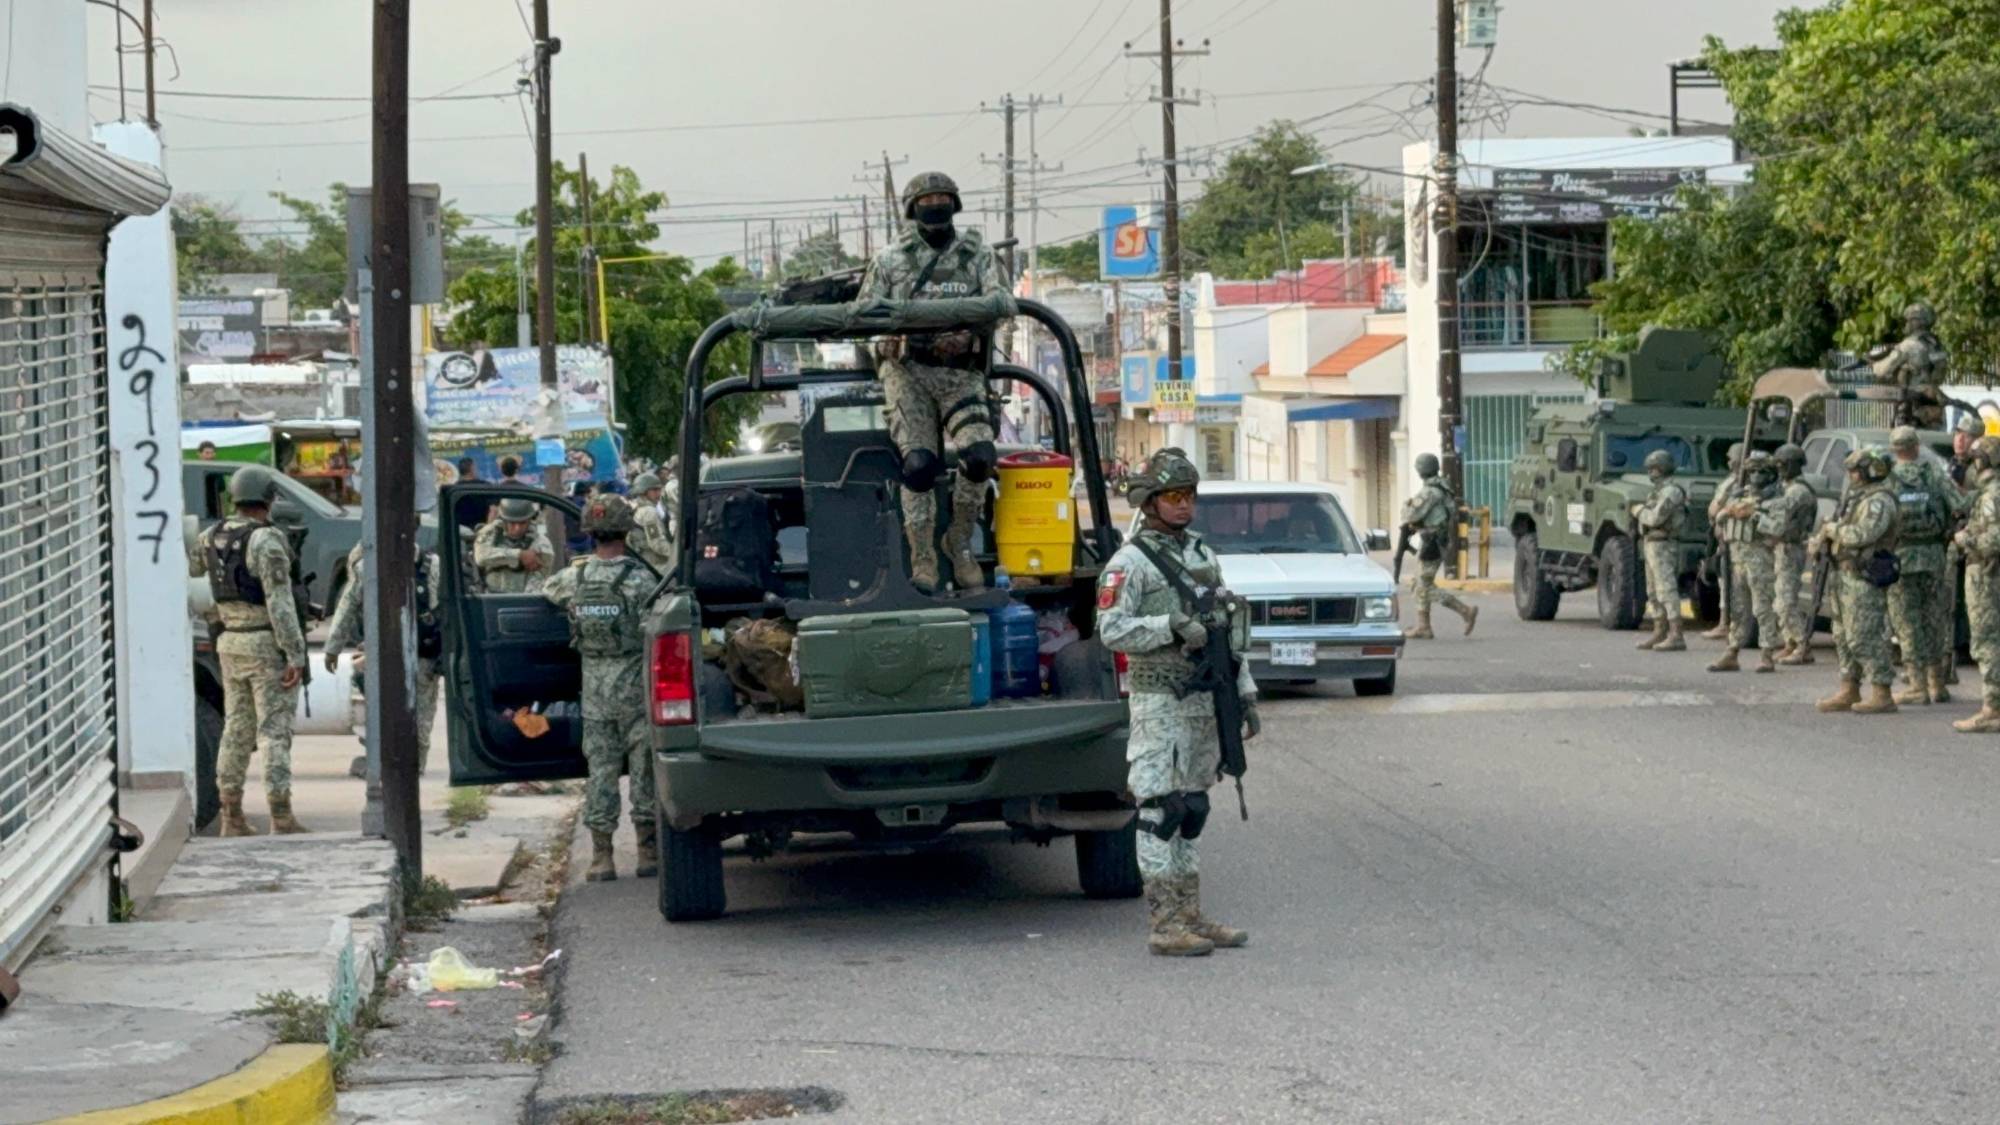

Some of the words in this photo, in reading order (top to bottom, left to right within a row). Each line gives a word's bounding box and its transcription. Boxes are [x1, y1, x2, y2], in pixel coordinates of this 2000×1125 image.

[1160, 392, 1189, 402] CASA
[119, 314, 168, 564] 2937
[1016, 480, 1053, 490] IGLOO
[1271, 606, 1307, 616] GMC
